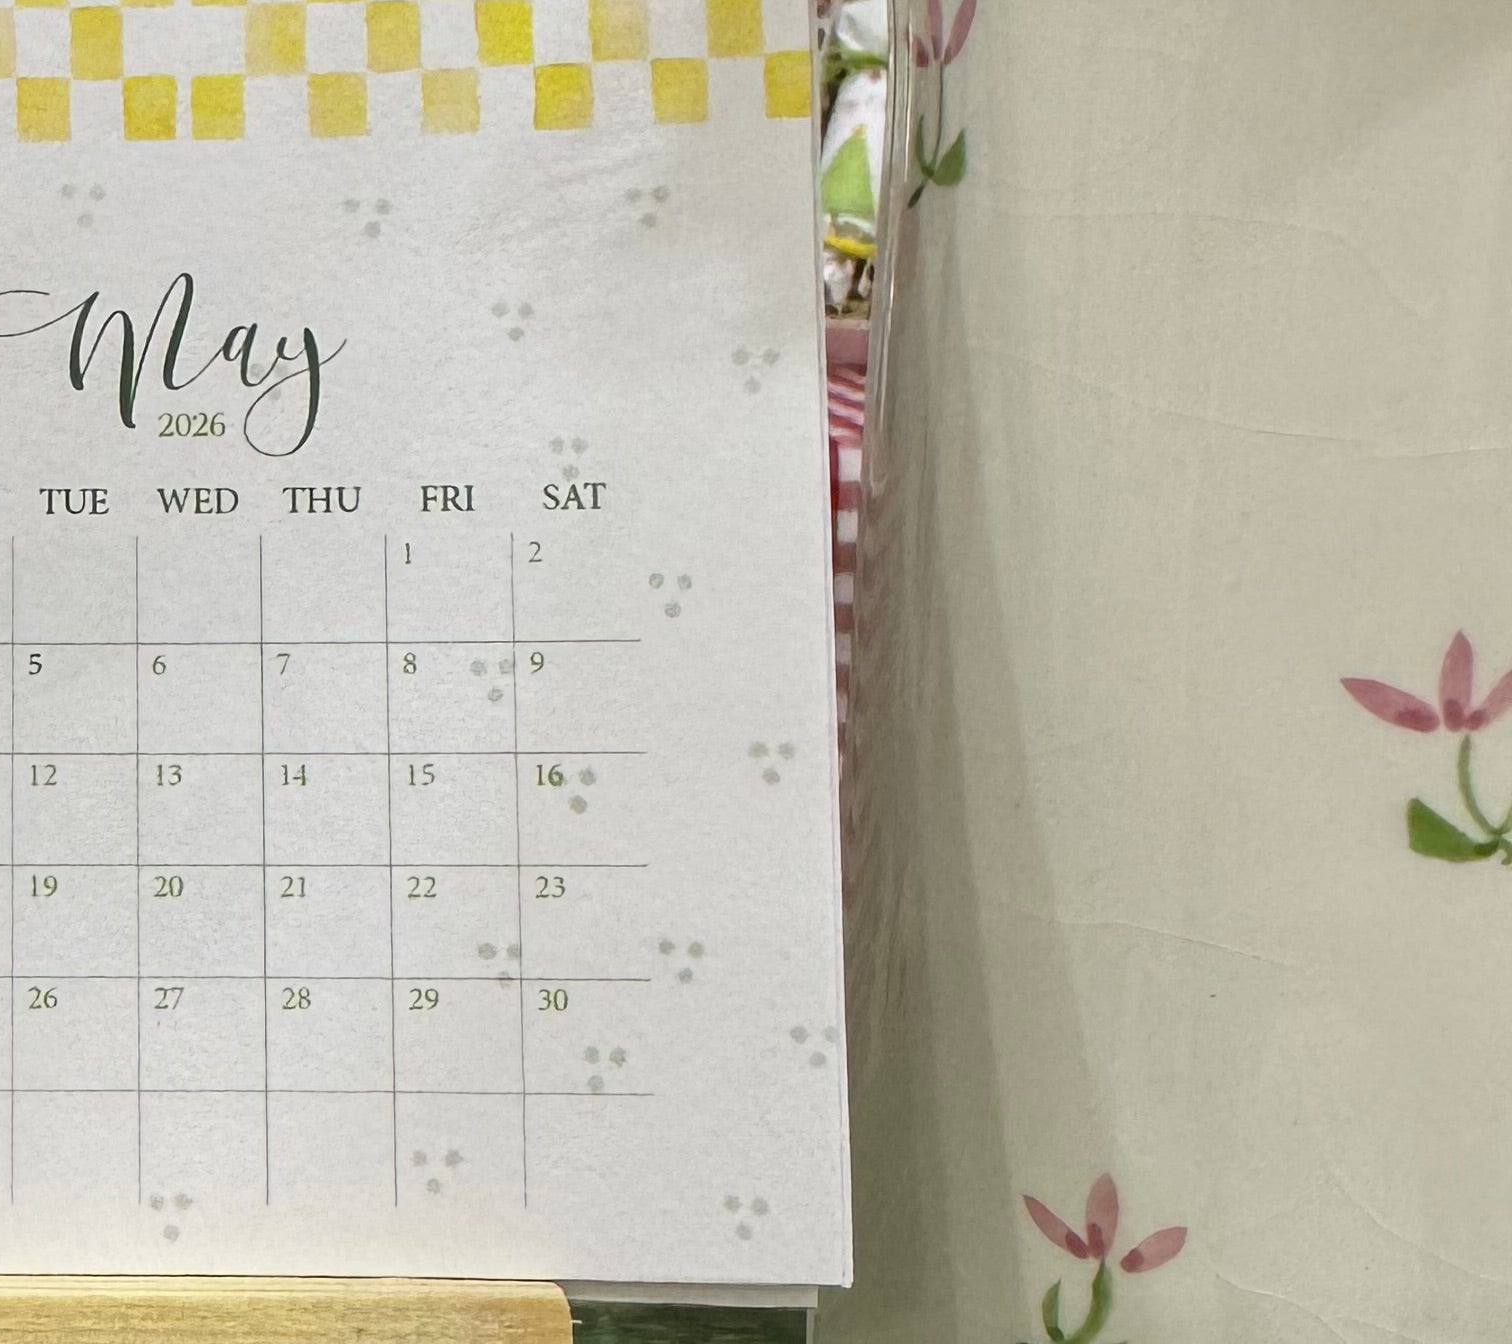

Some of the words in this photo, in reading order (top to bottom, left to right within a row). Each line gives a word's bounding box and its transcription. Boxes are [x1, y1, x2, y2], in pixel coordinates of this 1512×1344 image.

[158, 412, 227, 439] 2026
[40, 489, 109, 514] TUE
[157, 488, 238, 514] WED
[283, 487, 360, 513] THU
[421, 485, 475, 512] FRI
[544, 483, 606, 510] SAT
[404, 542, 412, 565] 1
[528, 541, 543, 563] 2
[28, 653, 43, 676] 5
[152, 655, 167, 676] 6
[276, 652, 291, 675] 7
[403, 652, 417, 675] 8
[530, 651, 545, 674] 9
[31, 763, 57, 787] 12
[157, 764, 182, 787] 13
[281, 764, 307, 787] 14
[408, 763, 436, 786] 15
[536, 763, 565, 787] 16
[31, 874, 58, 898] 19
[153, 875, 184, 898] 20
[280, 875, 306, 898] 21
[407, 875, 437, 899] 22
[535, 875, 566, 899] 23
[28, 986, 58, 1010] 26
[153, 986, 185, 1010] 27
[282, 987, 312, 1010] 28
[408, 987, 440, 1011] 29
[537, 988, 569, 1012] 30
